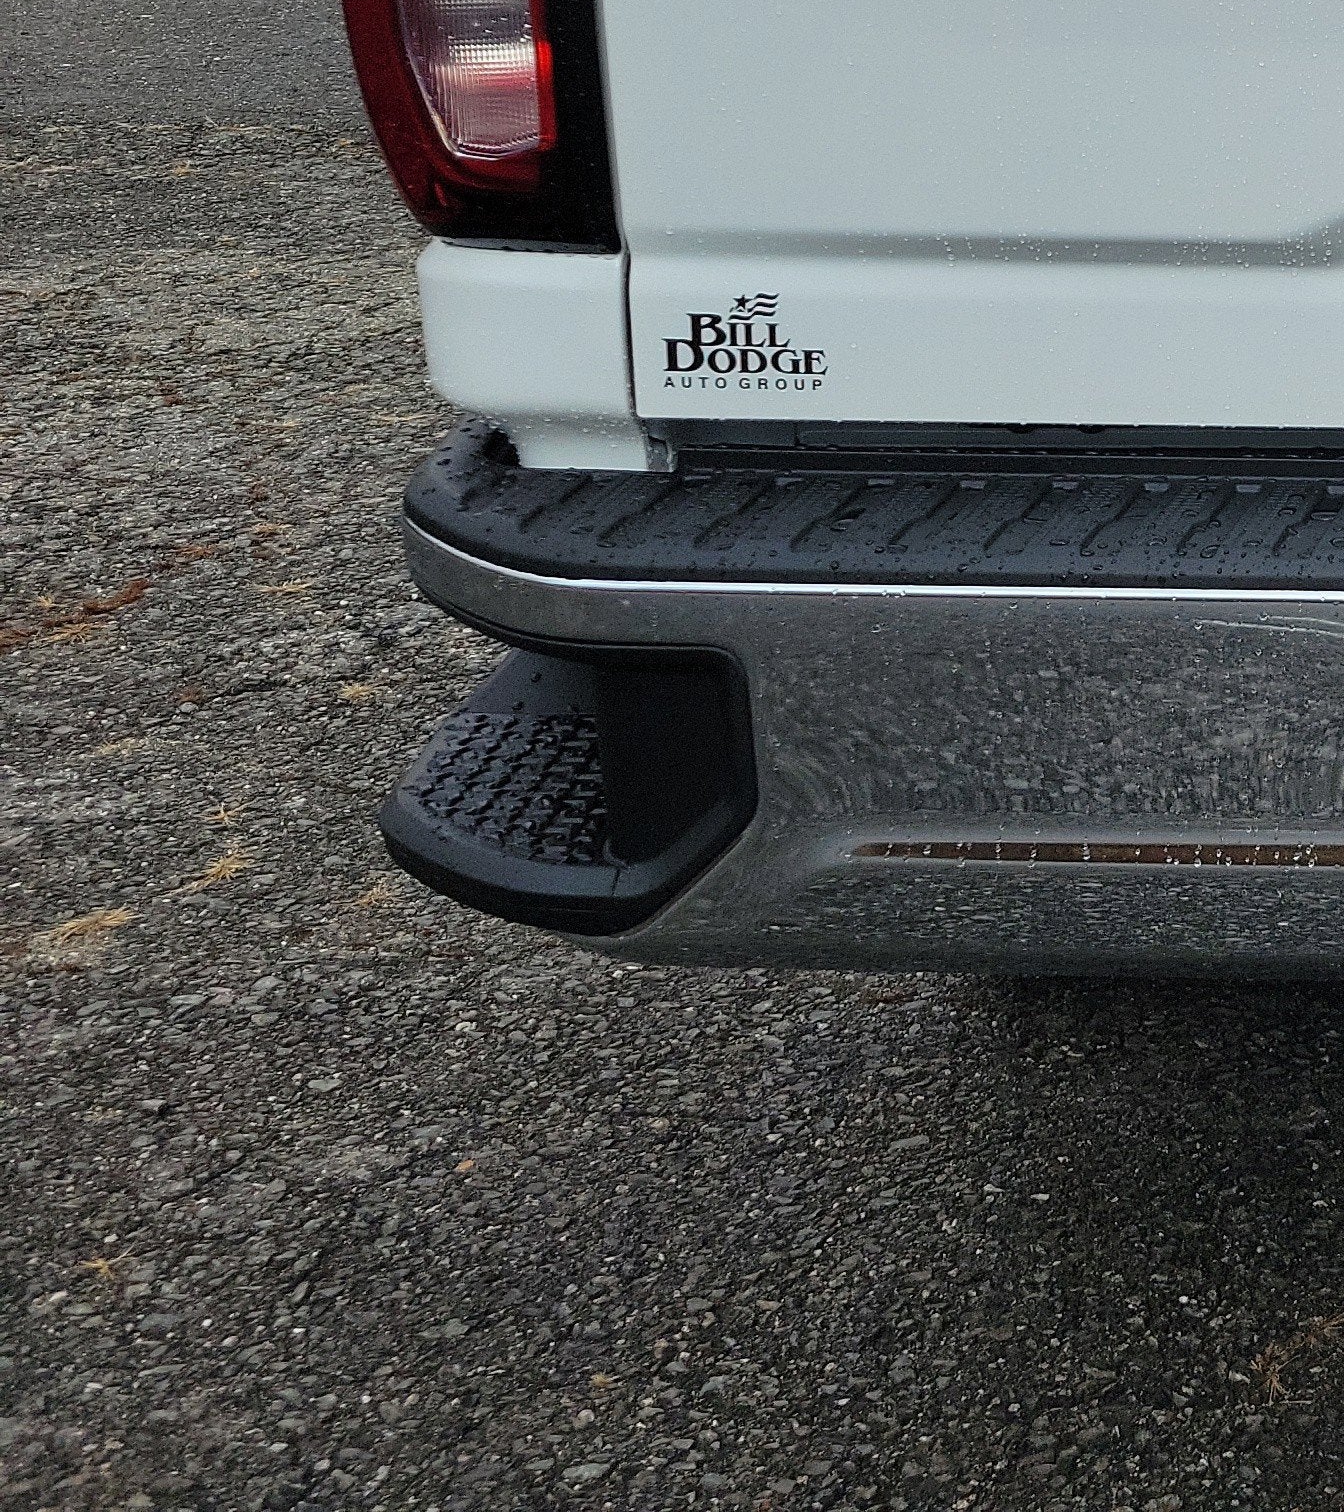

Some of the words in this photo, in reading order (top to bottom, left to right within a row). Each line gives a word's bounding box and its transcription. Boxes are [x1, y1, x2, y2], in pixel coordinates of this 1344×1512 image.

[686, 313, 790, 347] BILL
[661, 338, 829, 376] DODGE
[663, 377, 728, 389] AUTO
[738, 378, 823, 391] GROUP
